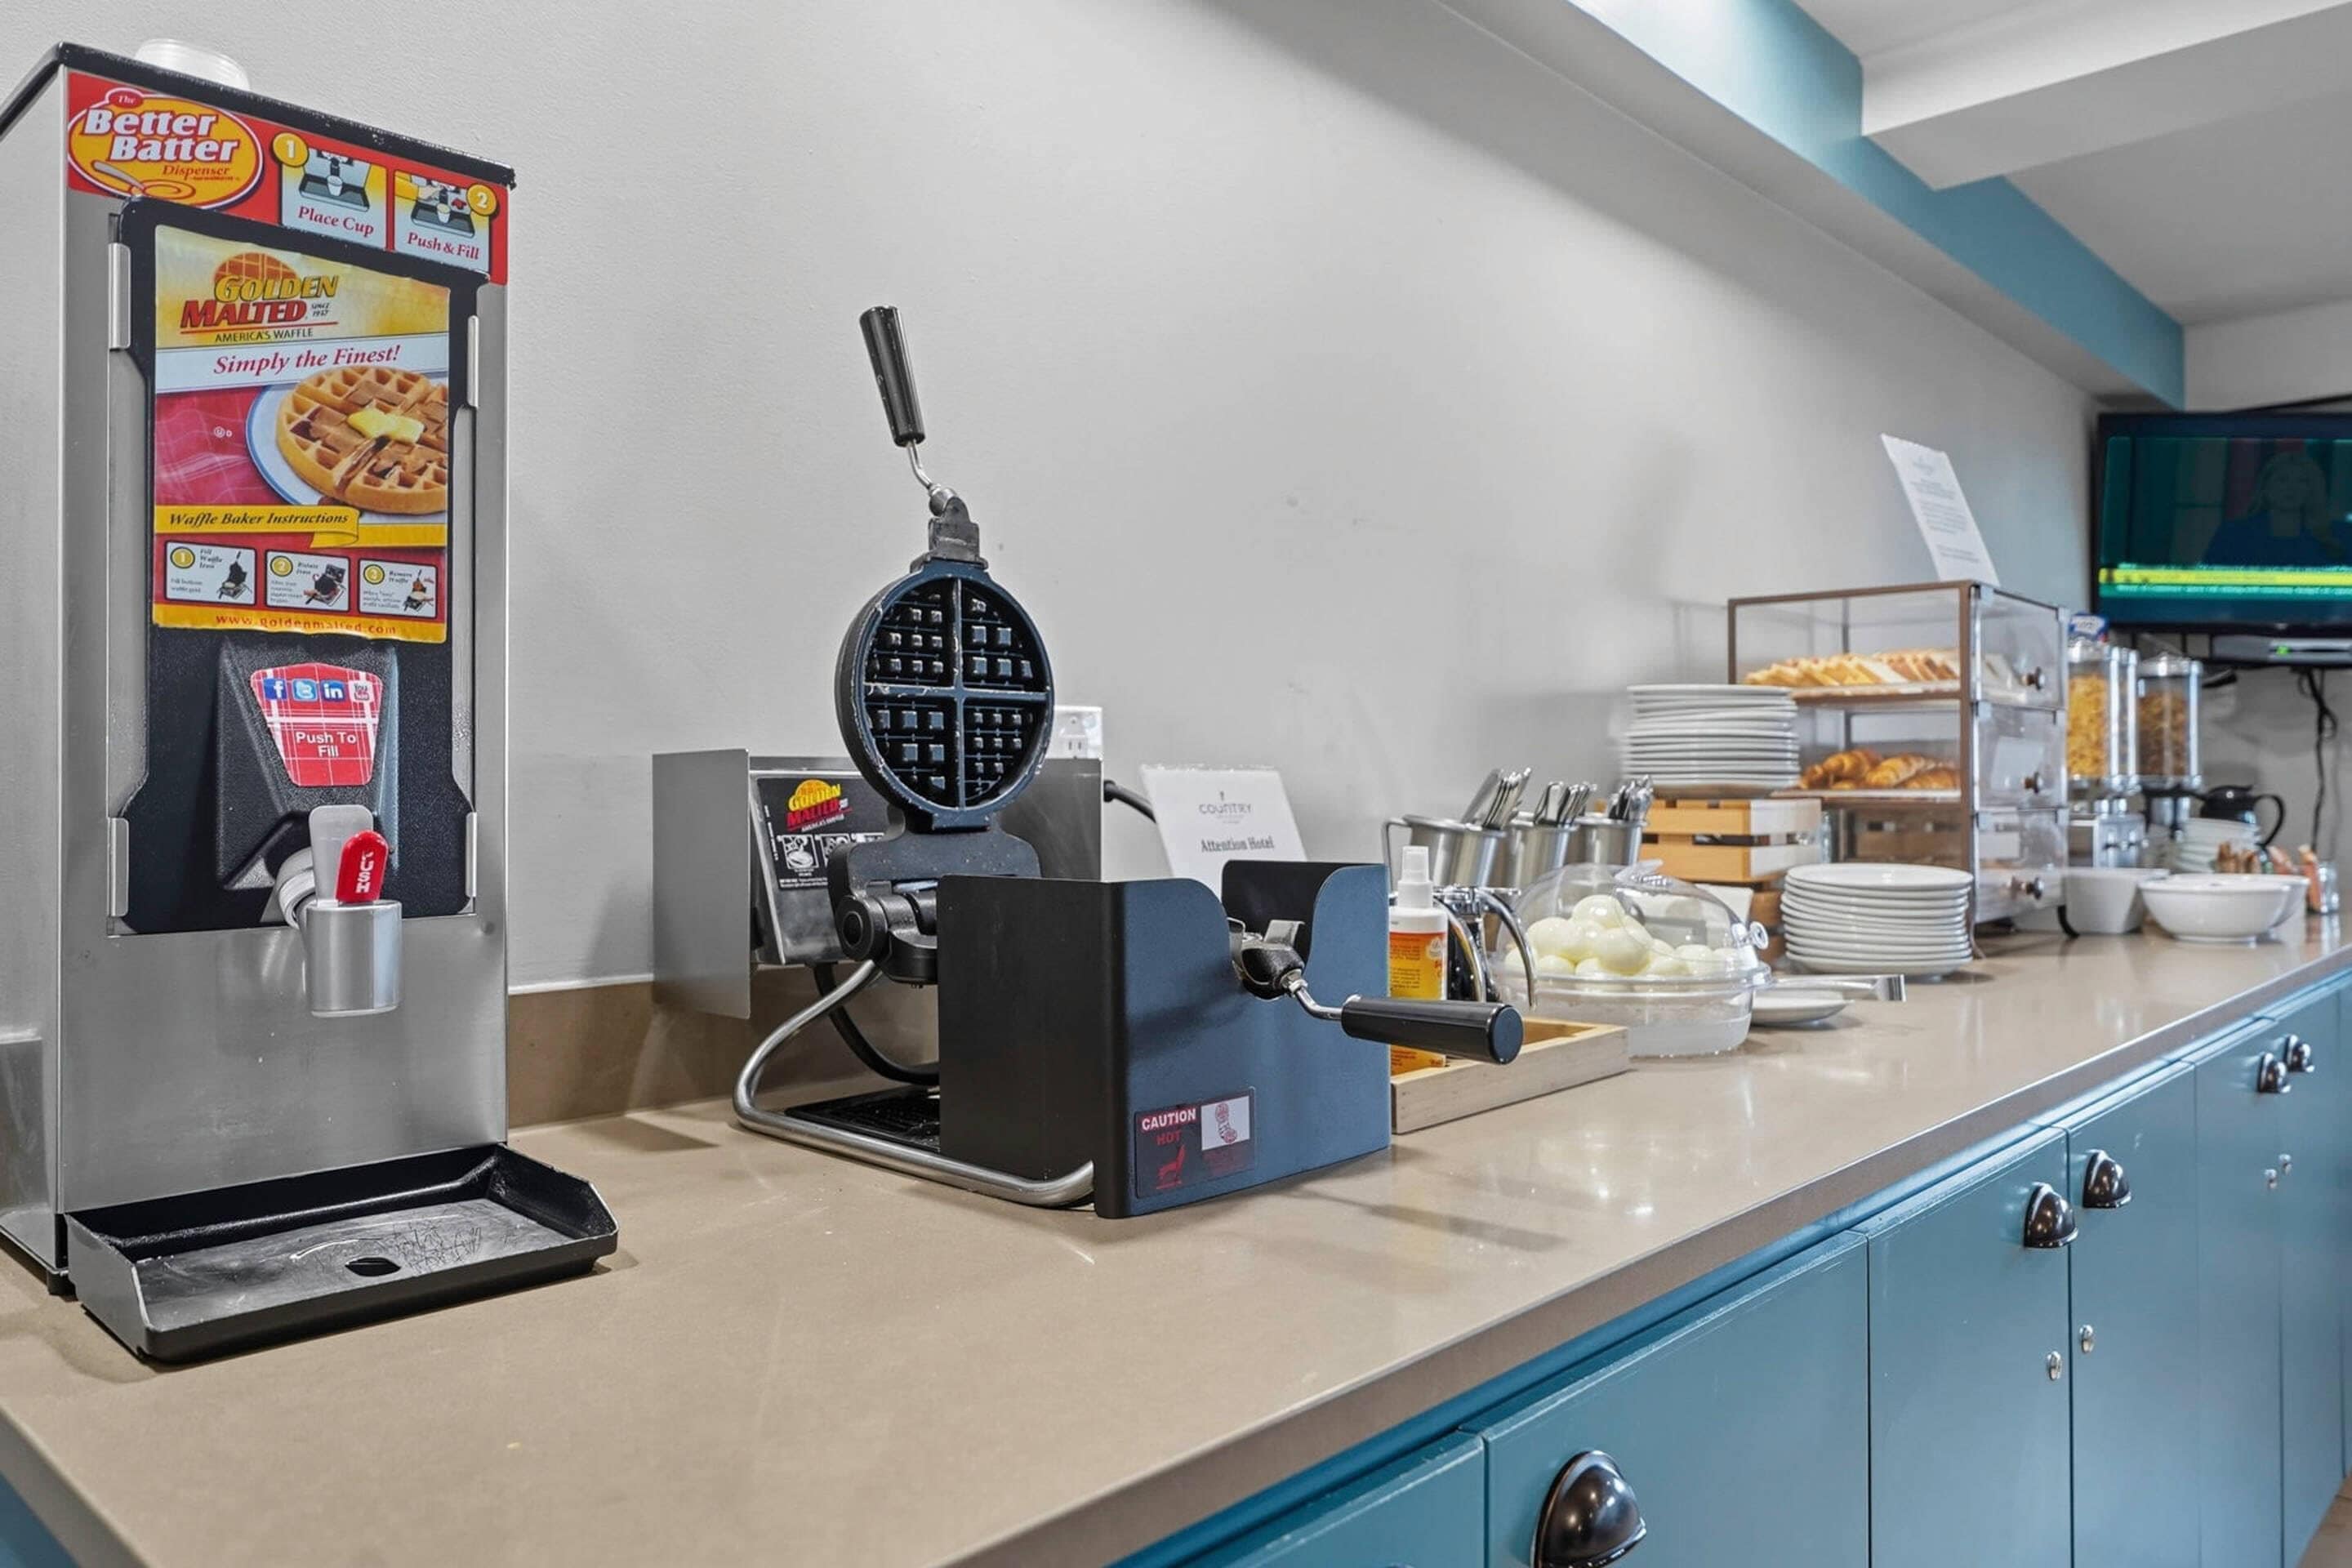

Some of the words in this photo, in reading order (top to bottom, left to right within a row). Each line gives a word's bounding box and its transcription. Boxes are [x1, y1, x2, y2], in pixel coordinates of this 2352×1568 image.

[118, 94, 135, 105] The
[83, 109, 217, 136] Better
[109, 136, 239, 162] Batter
[286, 140, 295, 158] 1
[163, 164, 229, 180] Dispenser
[476, 192, 488, 208] 2
[298, 206, 339, 227] Place
[343, 216, 374, 238] Cup
[408, 231, 441, 252] Push
[443, 244, 454, 255] &
[456, 244, 480, 260] Fill
[214, 274, 340, 302] GOLDEN
[180, 300, 309, 328] MALTED
[215, 330, 271, 342] AMERICA'S
[274, 327, 314, 339] WAFFLE
[214, 352, 290, 376] Simply
[296, 350, 327, 368] the
[333, 345, 401, 365] Finest!
[169, 513, 218, 528] Waffle
[221, 513, 264, 524] Baker
[266, 512, 348, 524] Instructions
[295, 731, 334, 744] Push
[336, 732, 357, 744] To
[318, 746, 339, 758] Fill
[1198, 803, 1252, 814] COUNTRY
[1200, 836, 1248, 852] Attention
[1247, 835, 1275, 850] Hotel
[1142, 1108, 1196, 1131] CAUTION
[1156, 1130, 1182, 1146] HOT
